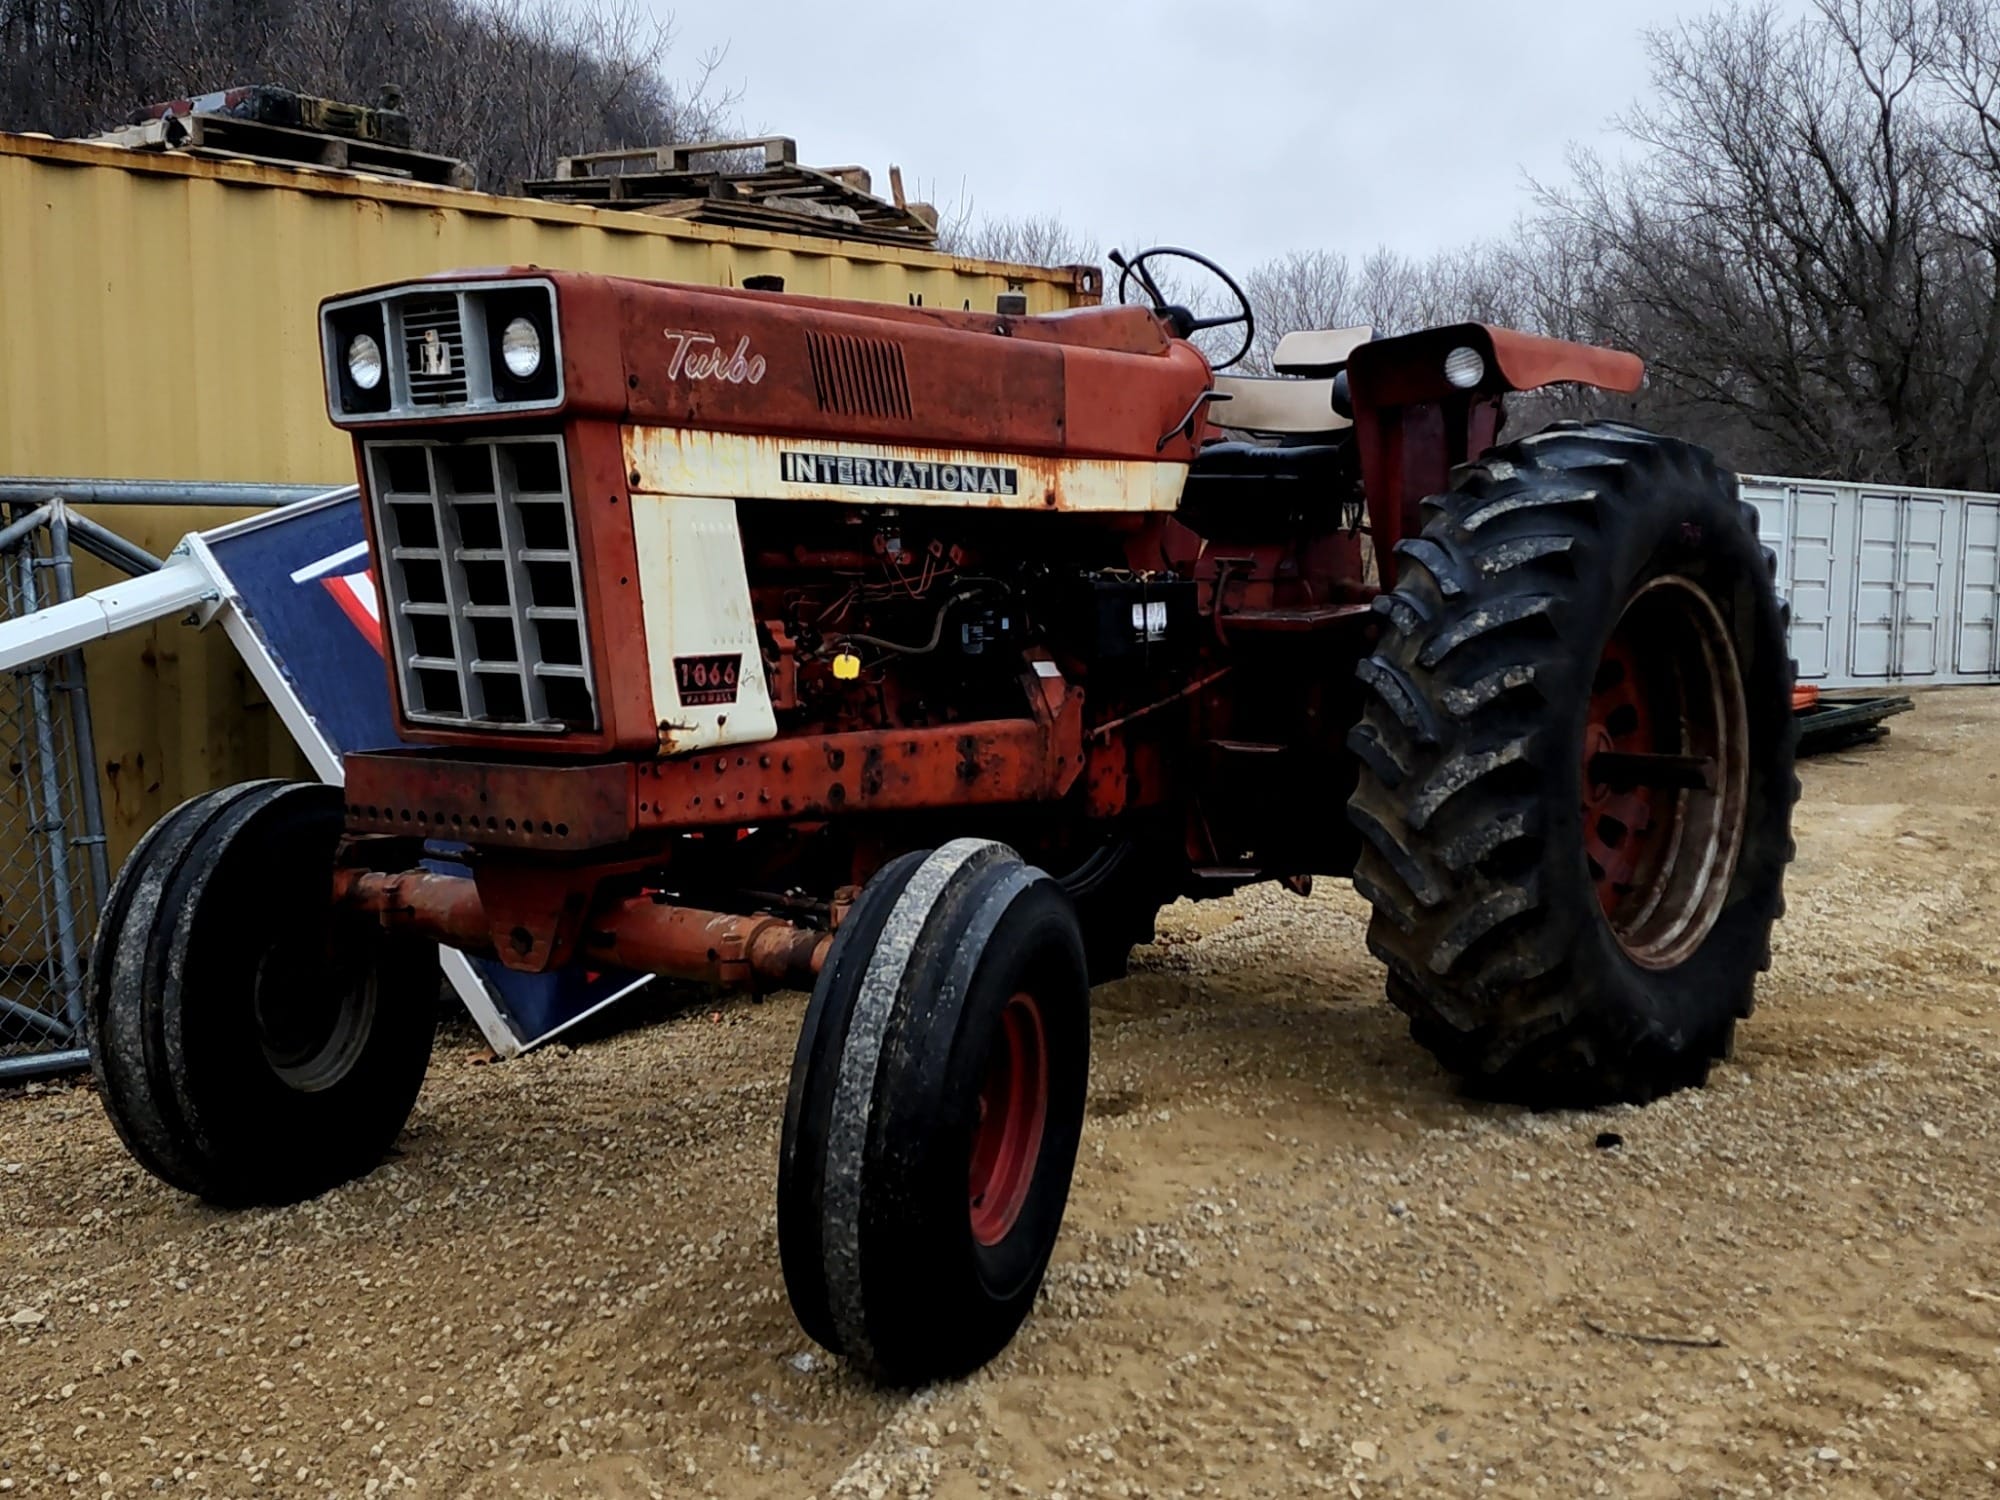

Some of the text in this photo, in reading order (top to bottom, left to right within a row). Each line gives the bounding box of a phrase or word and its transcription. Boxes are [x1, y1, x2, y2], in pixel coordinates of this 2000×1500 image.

[663, 328, 766, 384] Turbo
[786, 453, 1014, 494] INTERNATIONAL
[681, 661, 735, 687] 1066
